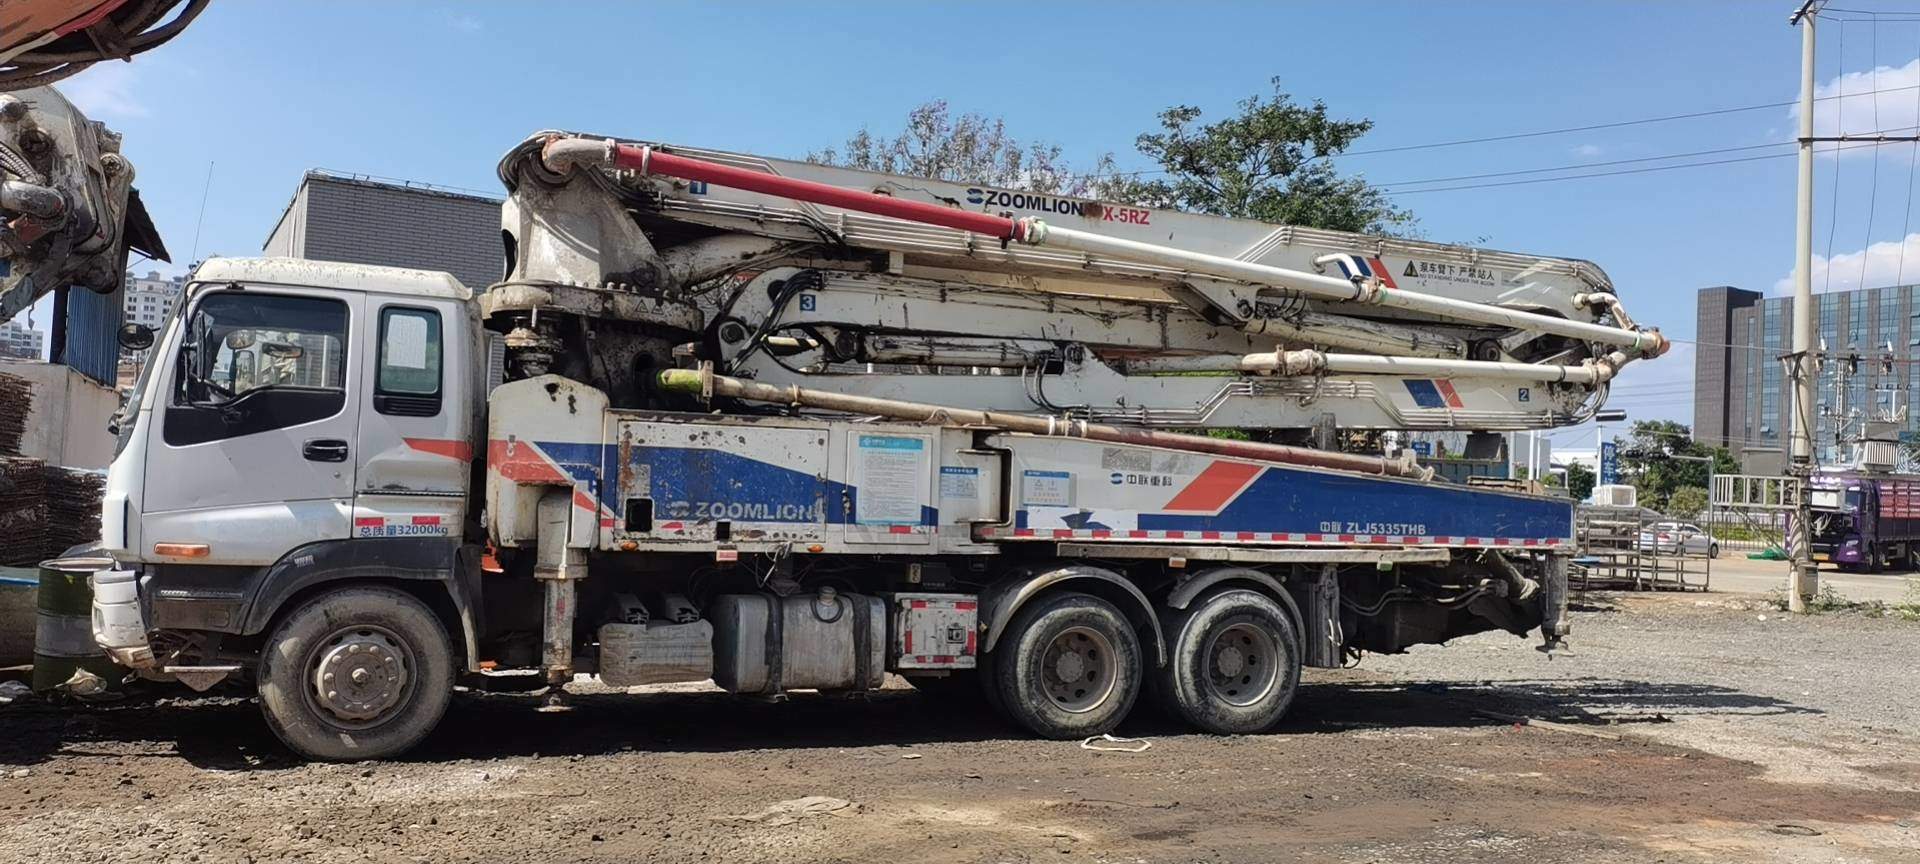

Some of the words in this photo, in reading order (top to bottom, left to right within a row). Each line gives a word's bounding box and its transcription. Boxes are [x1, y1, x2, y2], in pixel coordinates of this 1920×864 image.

[986, 190, 1084, 216] ZOOMLION
[802, 295, 813, 310] 3
[1520, 389, 1528, 400] 2
[1126, 474, 1173, 486] 中联重科
[695, 502, 812, 520] ZOOMLION
[1320, 521, 1342, 533] 中联
[1346, 522, 1426, 535] ZLJ5335THB
